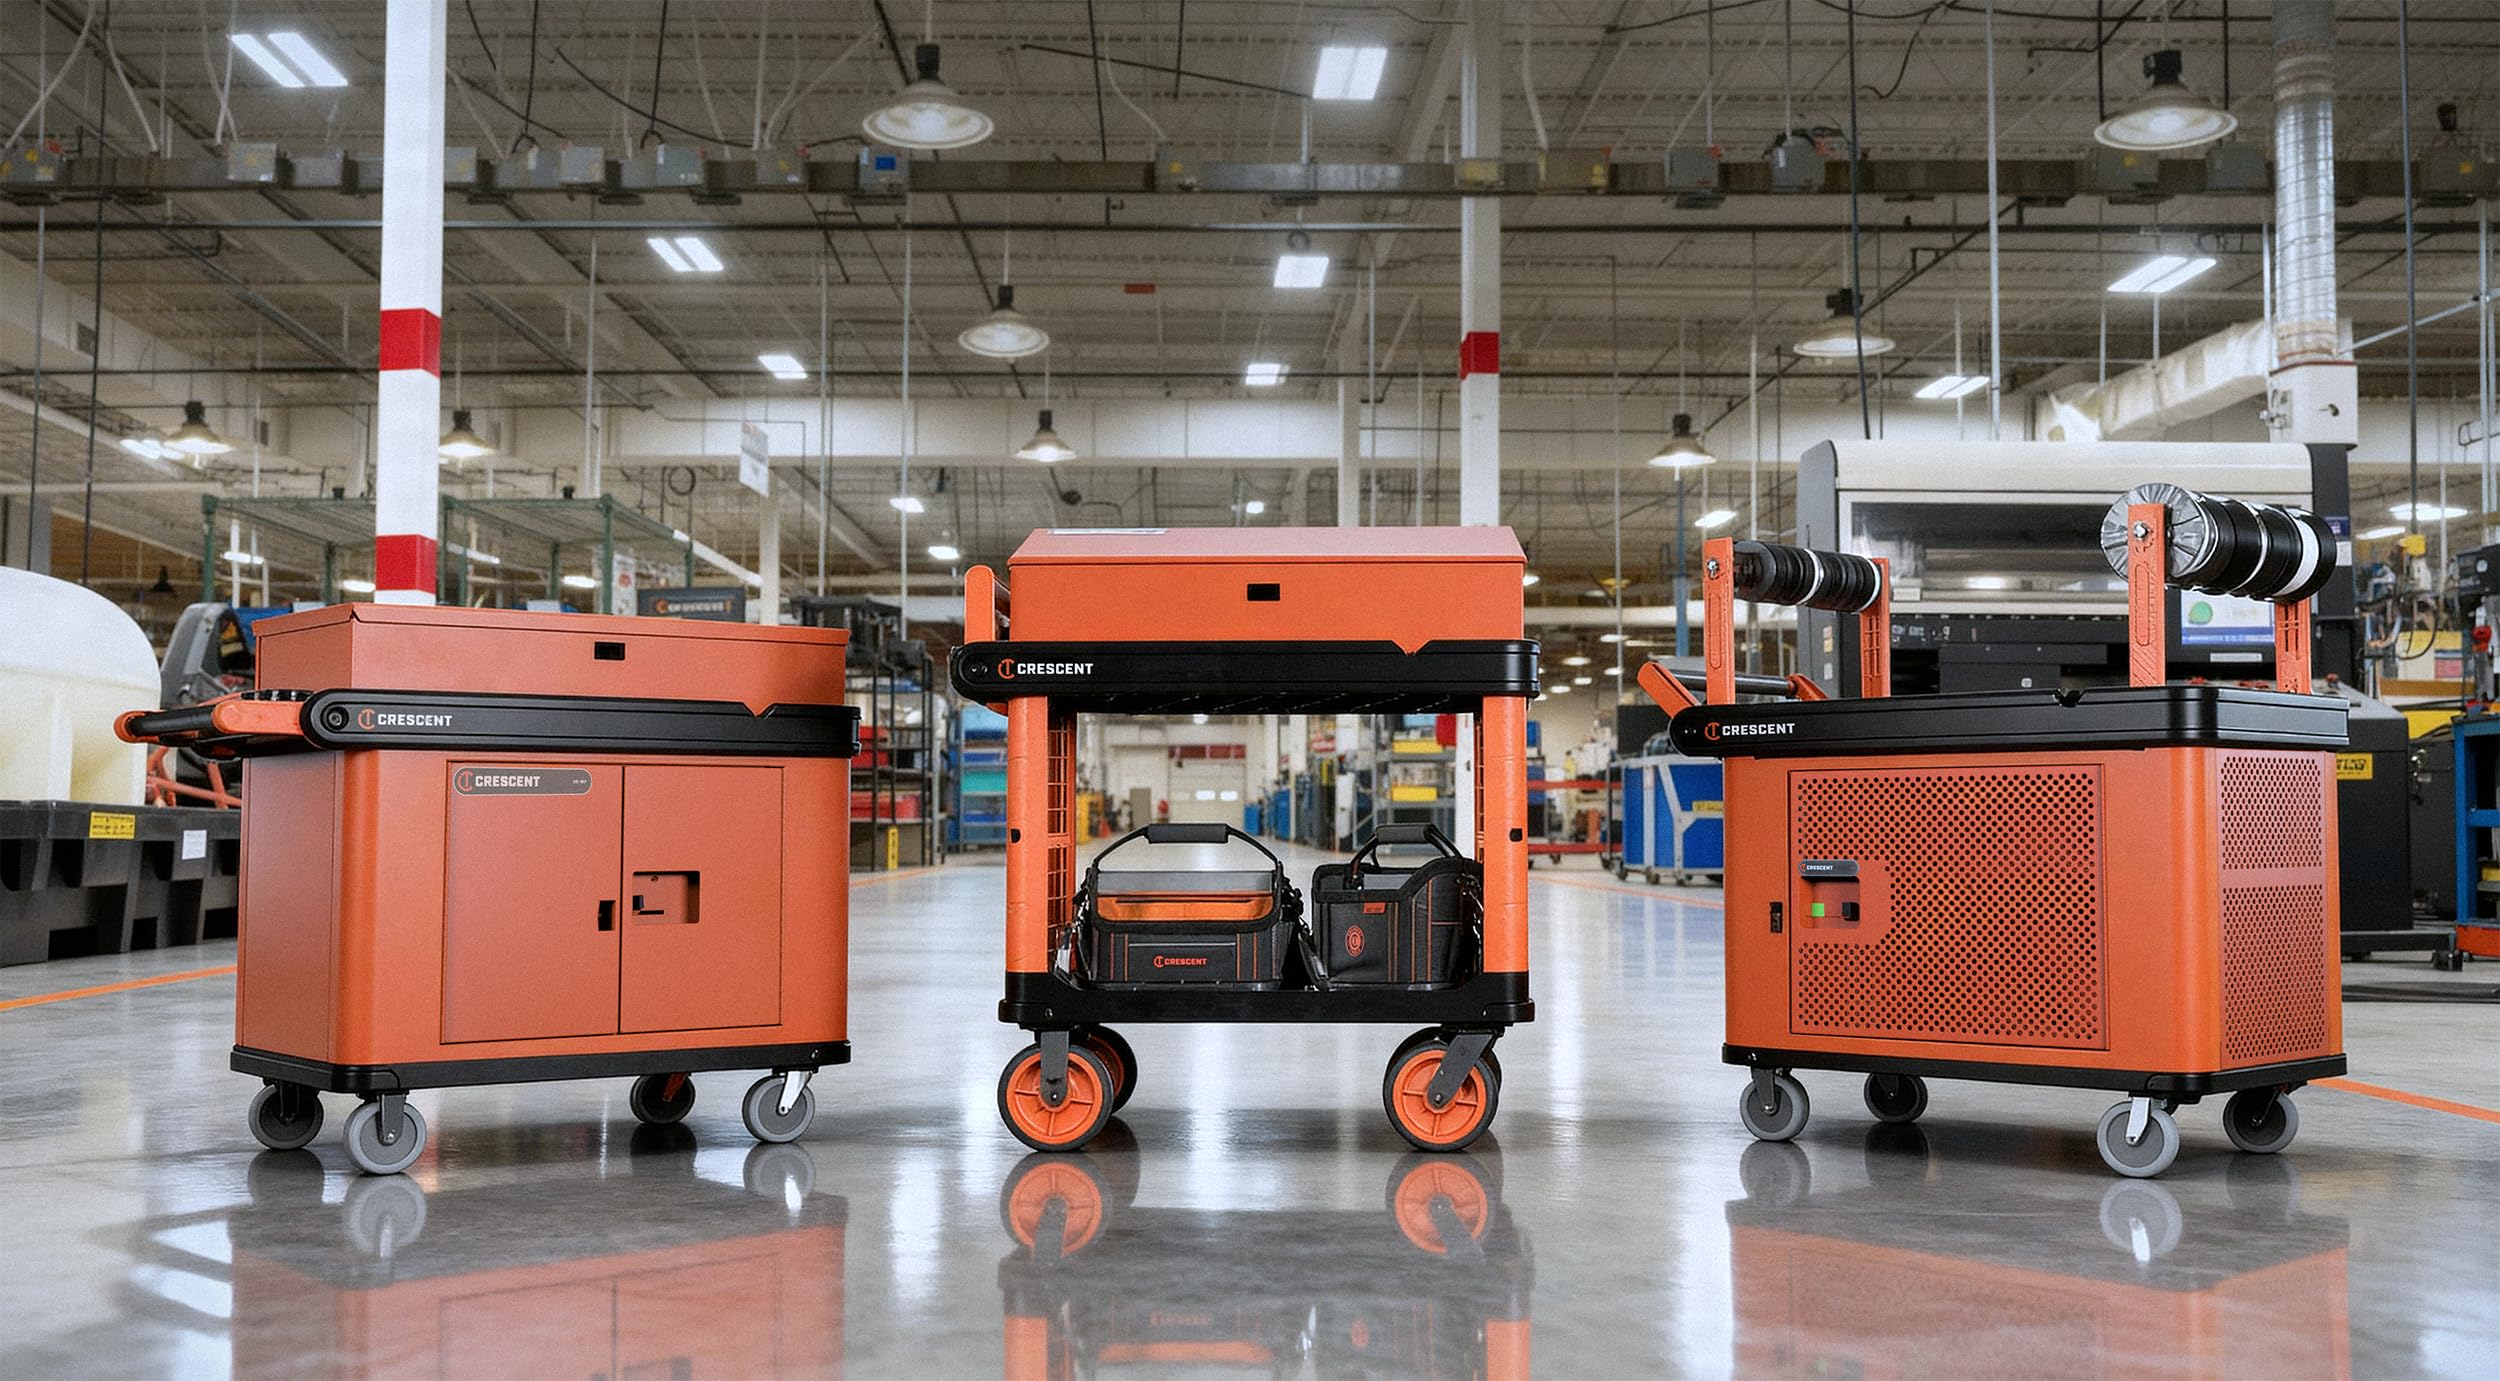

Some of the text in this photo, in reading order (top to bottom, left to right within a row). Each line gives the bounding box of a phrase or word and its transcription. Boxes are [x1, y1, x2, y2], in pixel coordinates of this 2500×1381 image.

[1017, 663, 1094, 675] CRESCENT
[377, 713, 453, 727] CRESCENT
[1722, 722, 1795, 736] CRESCENT
[475, 775, 541, 787] CRESCENT
[1164, 958, 1208, 966] CRESCENT
